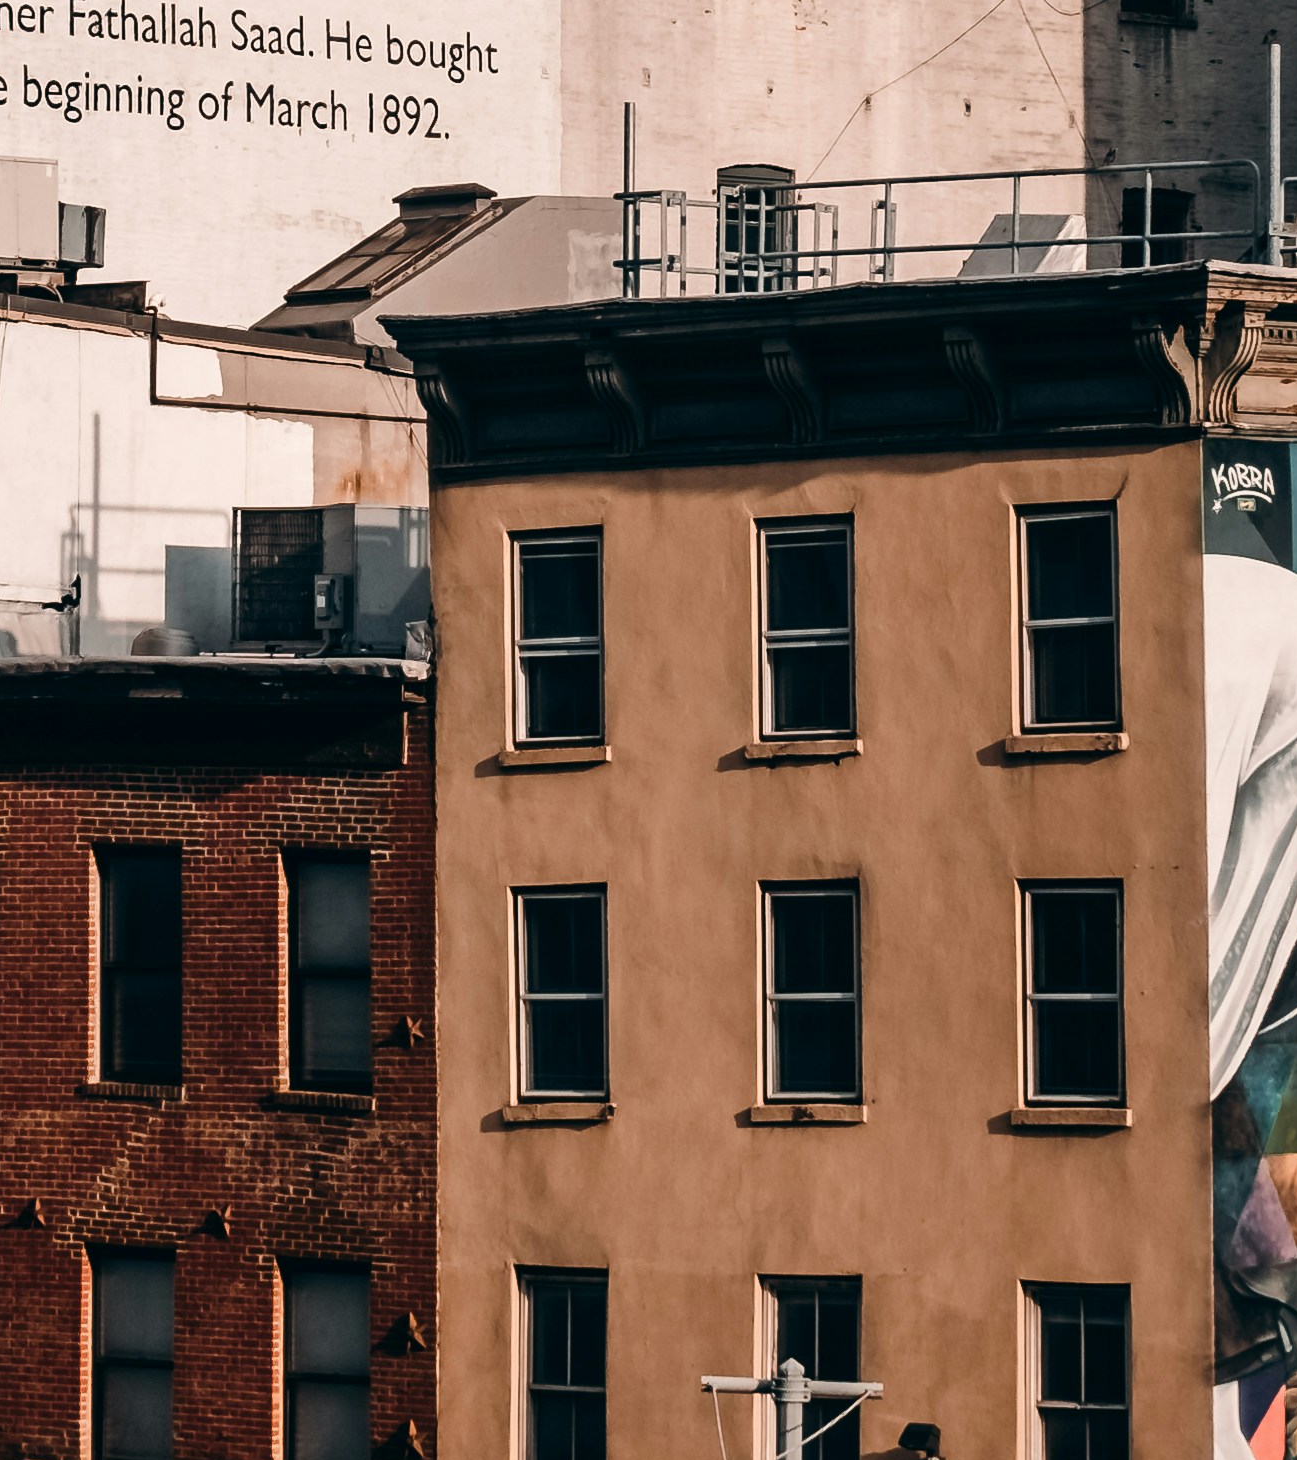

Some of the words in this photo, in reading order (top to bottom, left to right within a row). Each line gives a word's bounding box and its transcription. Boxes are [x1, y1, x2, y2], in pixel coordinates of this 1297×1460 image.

[231, 9, 314, 57] Saad.
[325, 18, 373, 63] He
[386, 23, 499, 84] bought
[23, 64, 185, 131] beginning
[198, 80, 234, 122] of
[246, 82, 348, 132] March
[368, 92, 450, 140] 1892.
[1211, 463, 1275, 496] KOBRA
